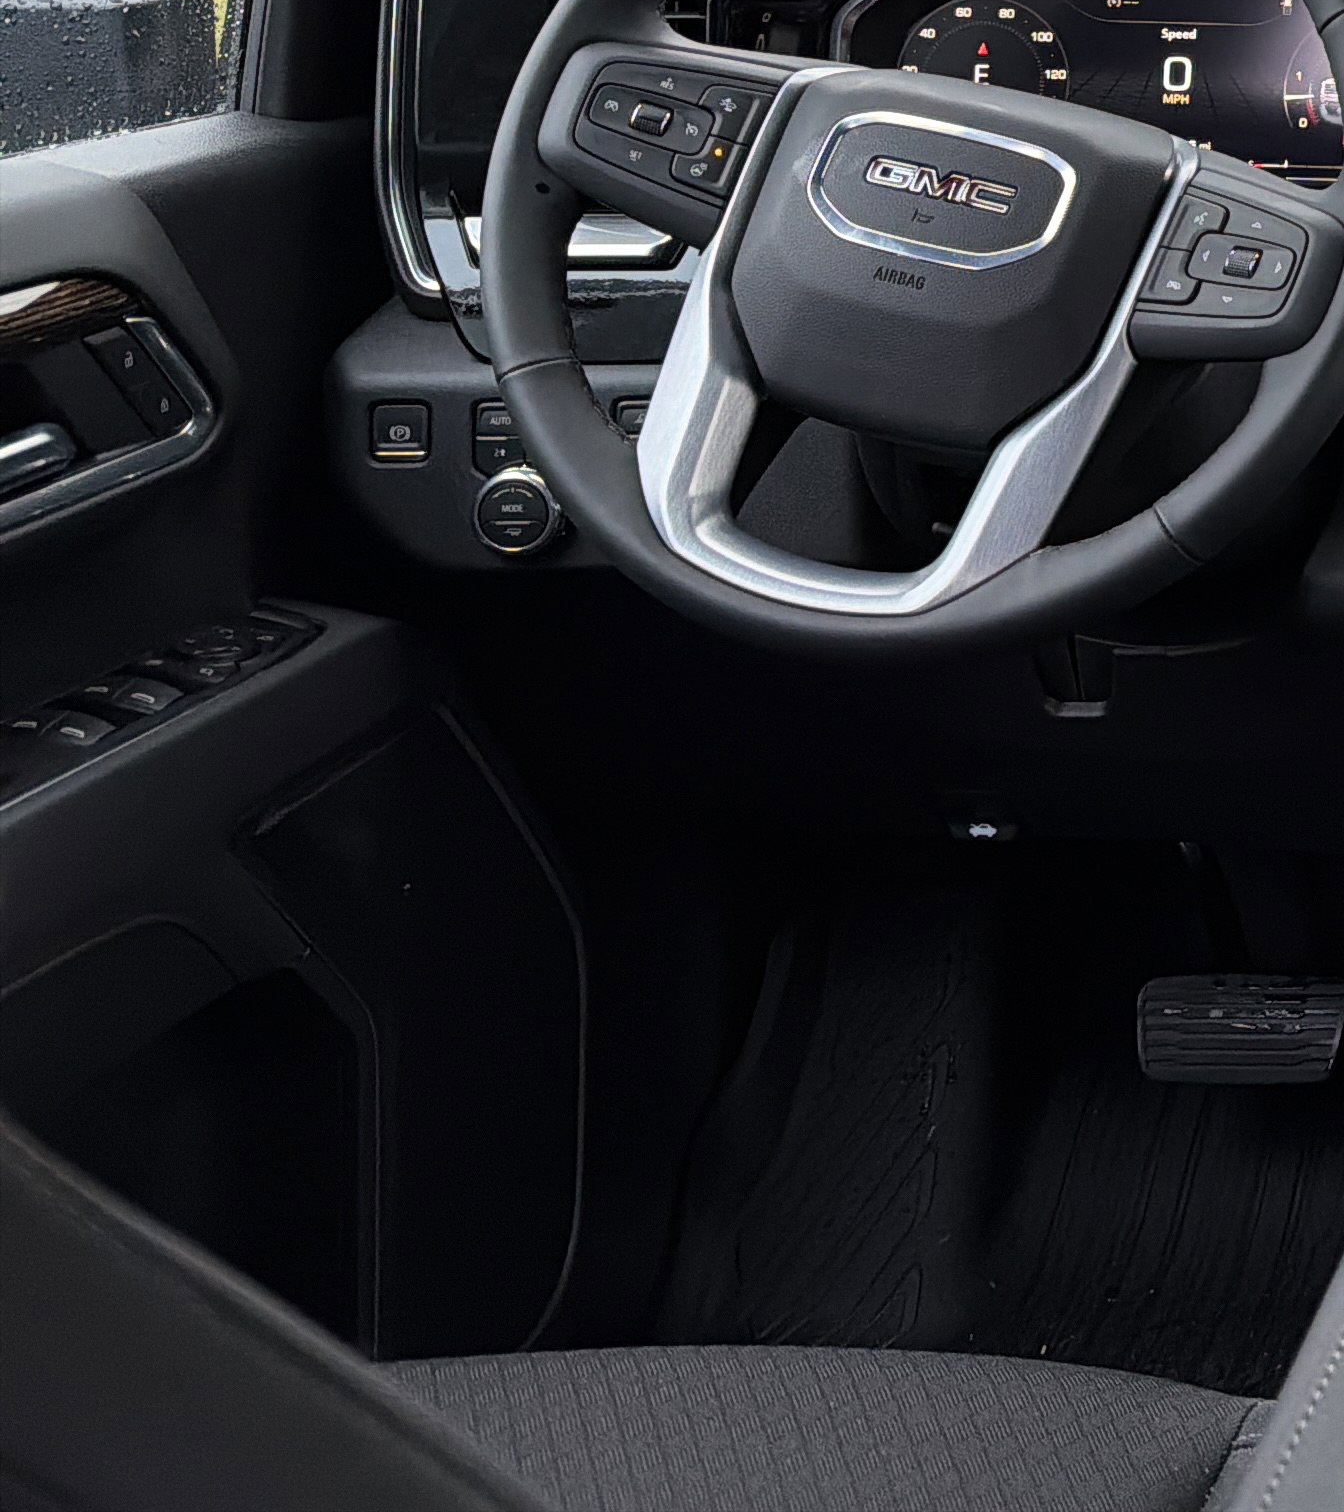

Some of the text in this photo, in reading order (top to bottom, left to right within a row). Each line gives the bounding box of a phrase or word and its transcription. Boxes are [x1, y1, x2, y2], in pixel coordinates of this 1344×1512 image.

[955, 7, 973, 18] 60
[999, 8, 1015, 19] 80
[919, 28, 936, 39] 40
[1031, 31, 1054, 43] 100
[1160, 27, 1198, 42] Speed
[1044, 69, 1067, 81] 120
[1162, 55, 1193, 92] 0
[1162, 94, 1191, 105] MPH
[1299, 118, 1308, 129] 0
[864, 156, 1018, 216] GMC
[873, 266, 926, 290] AIRBAG
[490, 416, 512, 426] AUTO
[501, 503, 525, 514] MODE
